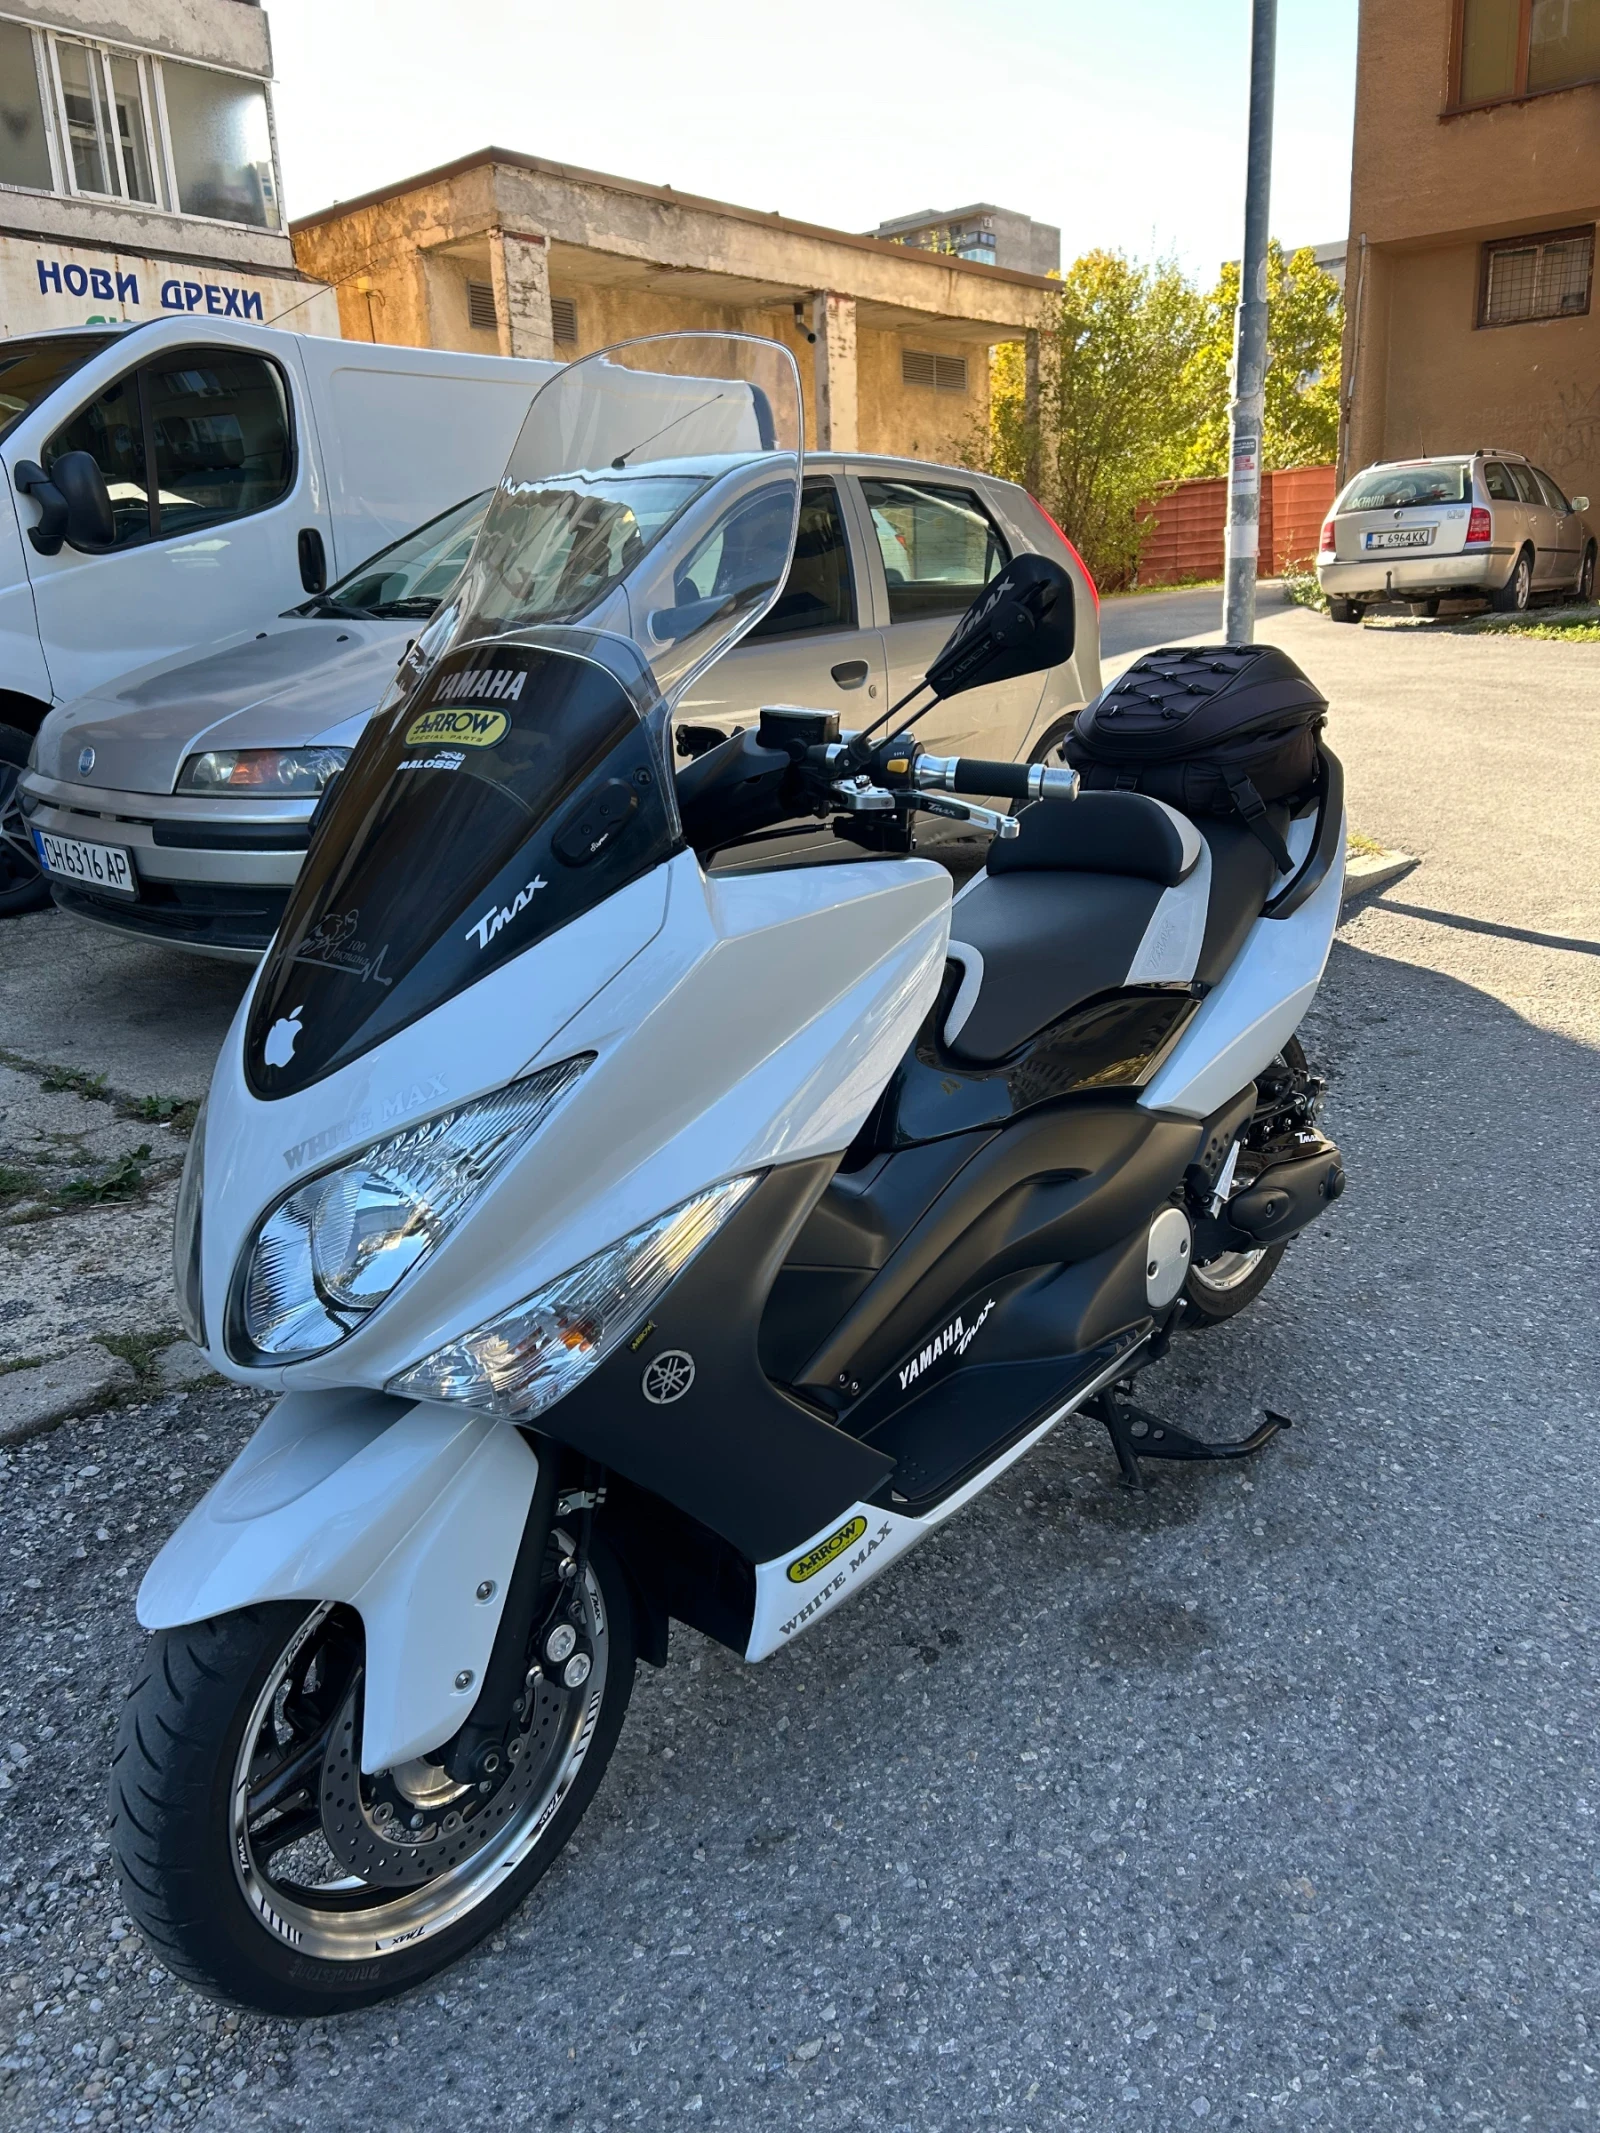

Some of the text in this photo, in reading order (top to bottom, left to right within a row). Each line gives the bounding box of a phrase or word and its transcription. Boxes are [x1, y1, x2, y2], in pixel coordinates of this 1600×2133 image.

[36, 259, 264, 320] НОВИ ДРЕХИ
[432, 669, 527, 702] YAMAHA
[409, 734, 483, 743] SPECIAL PARTS
[413, 712, 500, 734] ARROW
[397, 760, 462, 771] MALOSSI
[348, 940, 367, 952] 100
[283, 1071, 449, 1171] WHITE MAX
[899, 1316, 964, 1390] YAMAHA
[796, 1521, 857, 1576] ARROW
[779, 1520, 893, 1635] WHITE MAX
